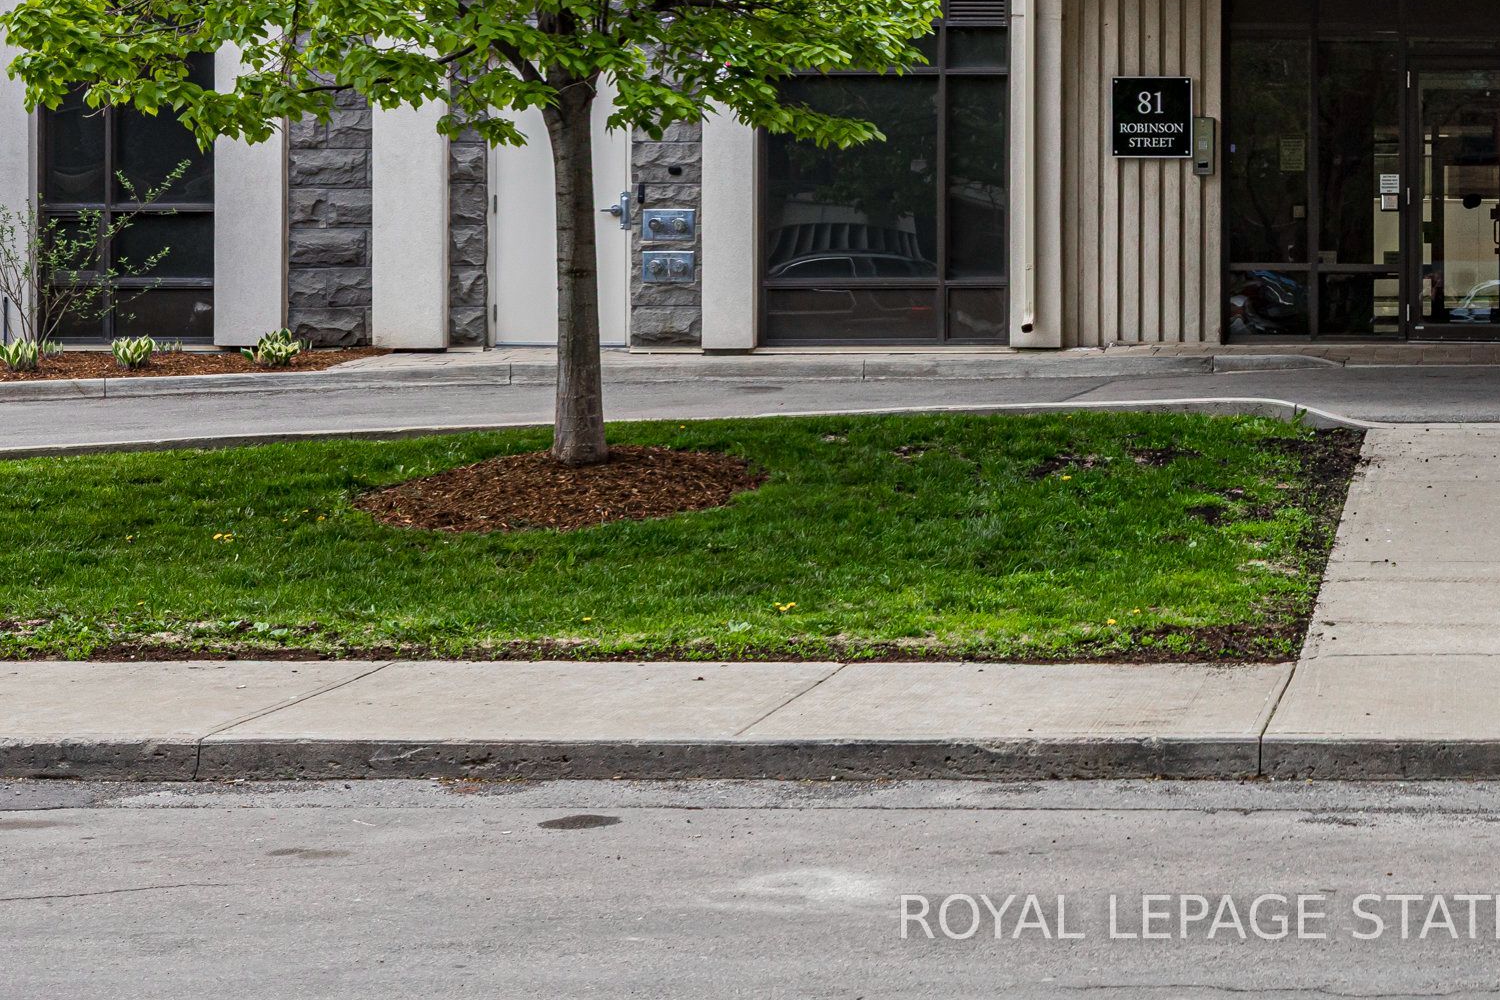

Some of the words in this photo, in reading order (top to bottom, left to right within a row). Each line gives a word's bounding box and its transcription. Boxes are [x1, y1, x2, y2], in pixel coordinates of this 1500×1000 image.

[1137, 91, 1164, 114] 81
[1119, 122, 1184, 134] ROBINSON
[1128, 137, 1175, 148] STREET
